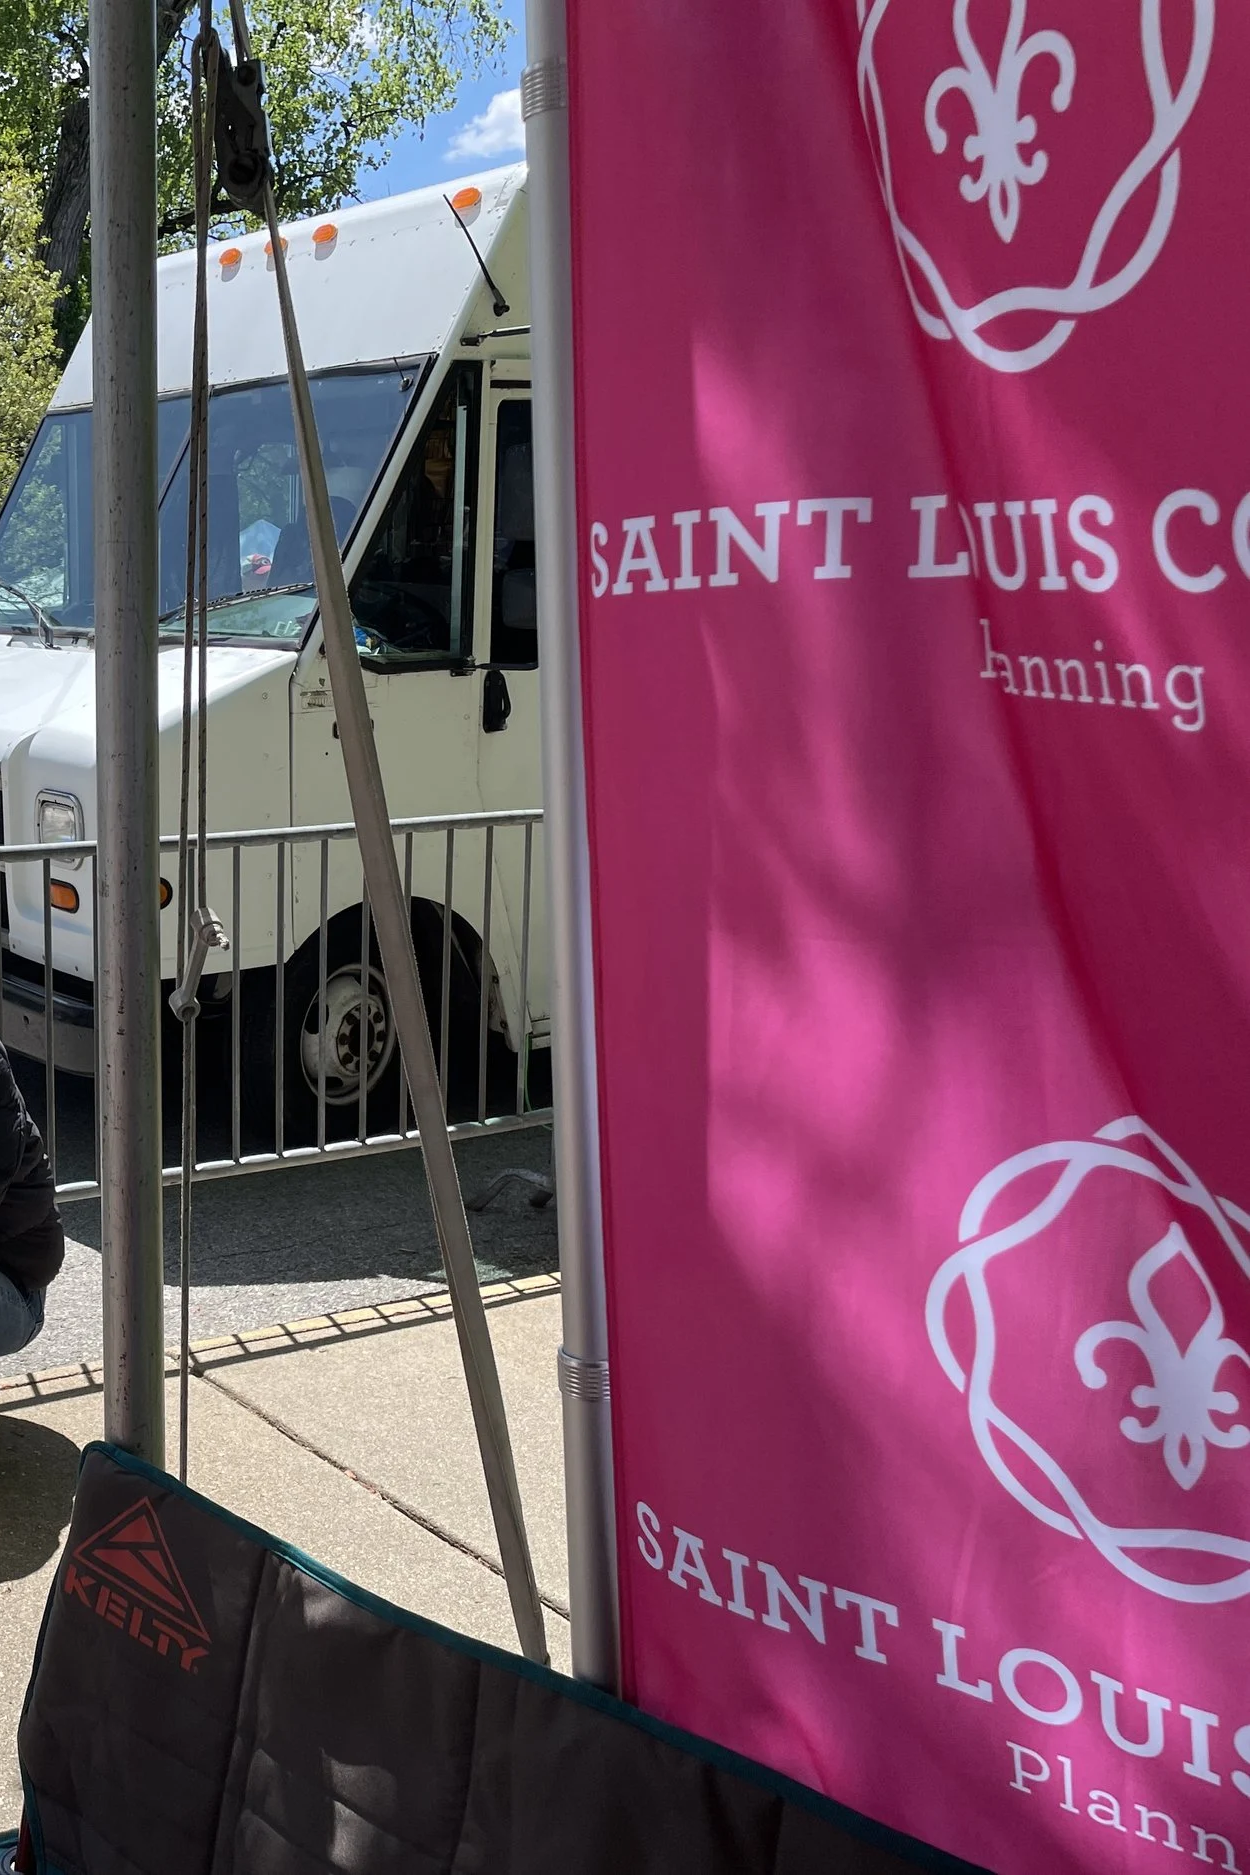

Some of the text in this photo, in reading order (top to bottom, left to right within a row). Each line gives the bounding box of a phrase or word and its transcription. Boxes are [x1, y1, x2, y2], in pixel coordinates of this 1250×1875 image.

[590, 487, 1250, 598] SAINT LUIS C
[64, 1563, 210, 1673] KELTY
[636, 1500, 899, 1664] SAINT
